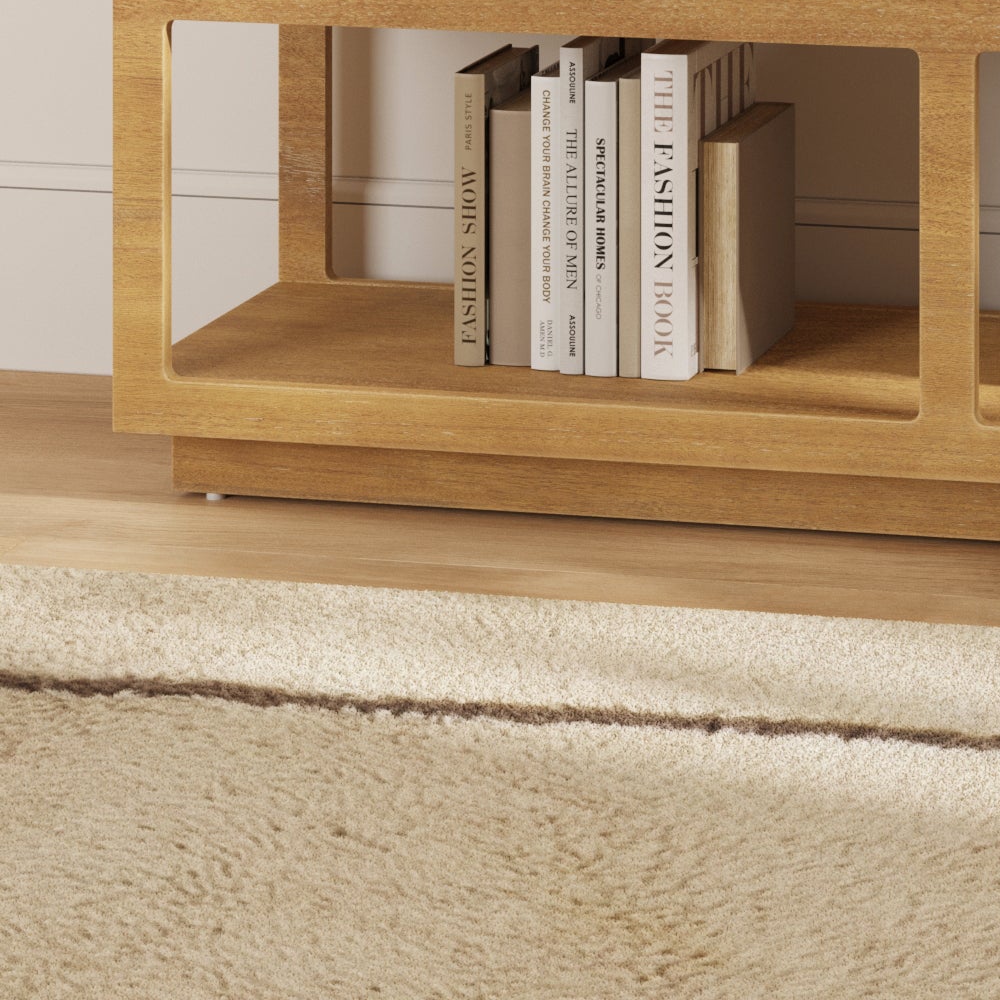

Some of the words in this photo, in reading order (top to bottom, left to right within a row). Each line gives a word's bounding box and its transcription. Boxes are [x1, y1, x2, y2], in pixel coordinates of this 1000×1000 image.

[464, 93, 473, 120] STYLE
[542, 89, 551, 132] CHANGE
[653, 70, 673, 133] THE
[464, 124, 473, 151] PARIS
[542, 135, 551, 162] YOUR
[566, 129, 577, 160] THE
[461, 165, 477, 235] SHOW
[542, 165, 551, 197] BRAIN
[566, 163, 578, 226] ALLURE
[595, 137, 606, 224] SPECTACULAR
[542, 200, 551, 242] CHANGE
[653, 140, 674, 272] FASHION
[542, 245, 551, 273] YOUR
[566, 230, 578, 250] OF
[595, 227, 606, 270] HOMES
[542, 275, 551, 304] BODY
[566, 254, 578, 290] MEN
[595, 274, 602, 283] OF
[461, 245, 477, 344] FASHION
[653, 280, 674, 358] BOOK
